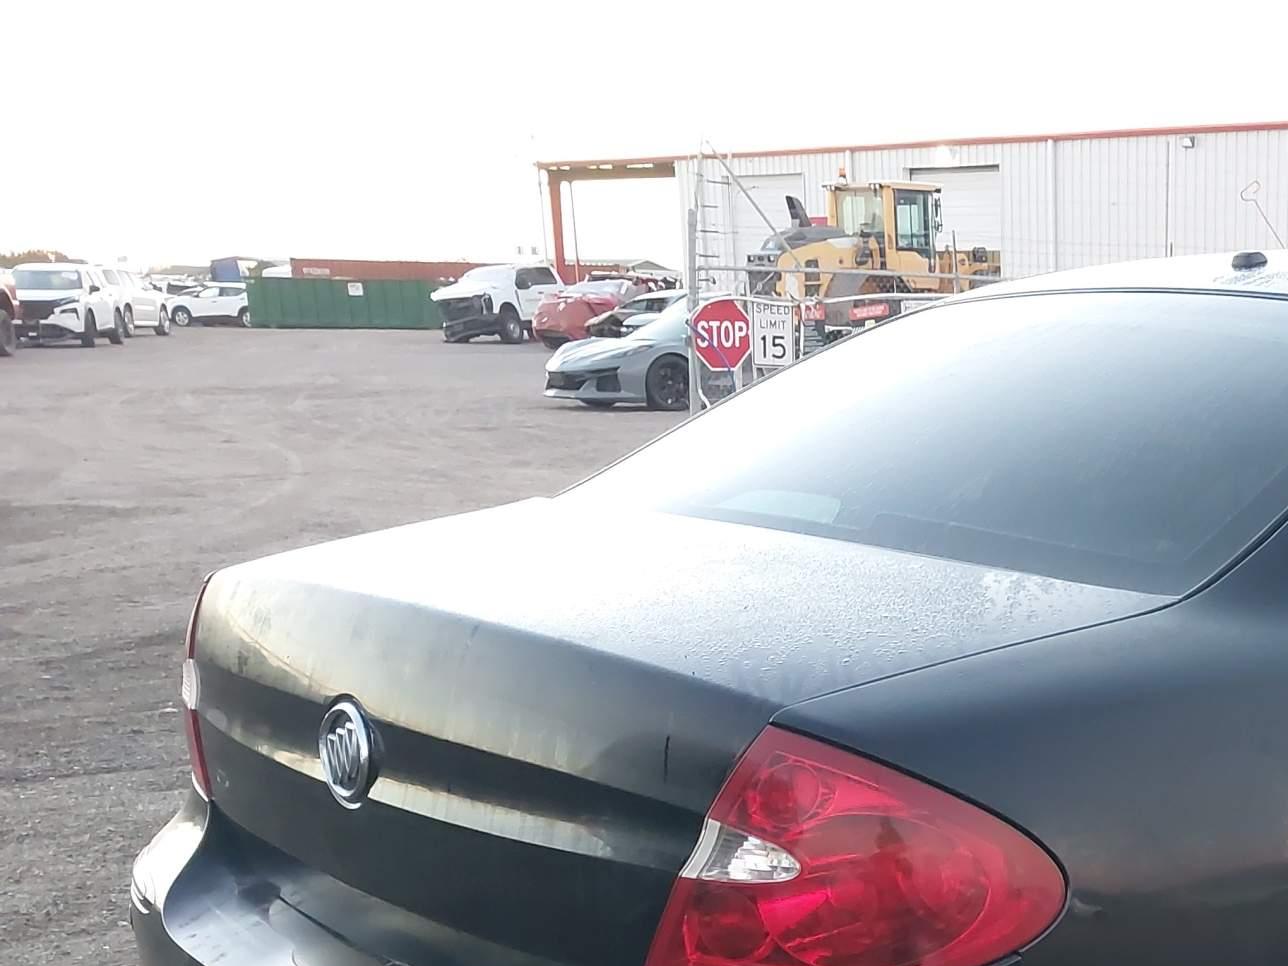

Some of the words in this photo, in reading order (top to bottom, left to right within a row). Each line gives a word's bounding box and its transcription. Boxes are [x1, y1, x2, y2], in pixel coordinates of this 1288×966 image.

[756, 303, 790, 316] SPEED
[759, 319, 786, 330] LIMIT
[696, 320, 748, 348] STOP
[760, 335, 787, 359] 15
